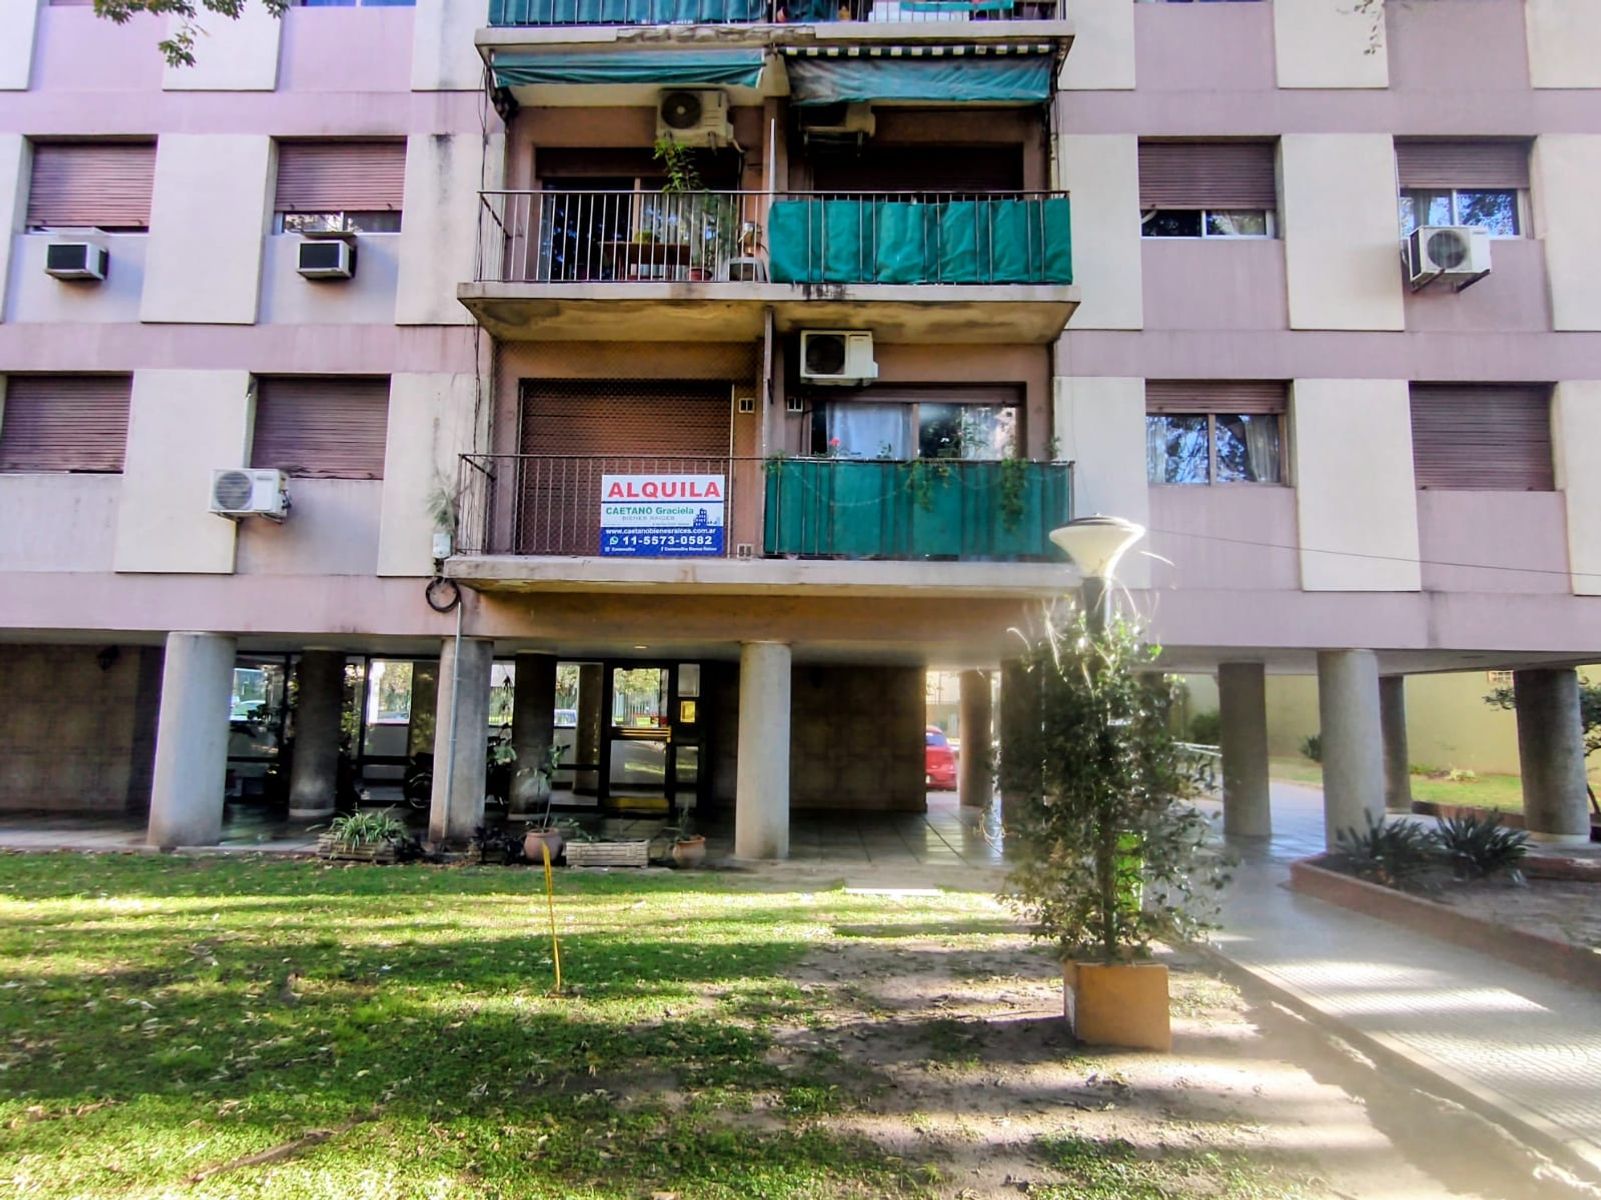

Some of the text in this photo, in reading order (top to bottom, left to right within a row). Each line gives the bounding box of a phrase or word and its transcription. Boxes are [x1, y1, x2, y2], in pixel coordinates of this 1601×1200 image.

[608, 482, 721, 498] ALQUILA
[606, 507, 694, 515] CAETANO Graciela
[623, 536, 713, 545] 11-5573-0582
